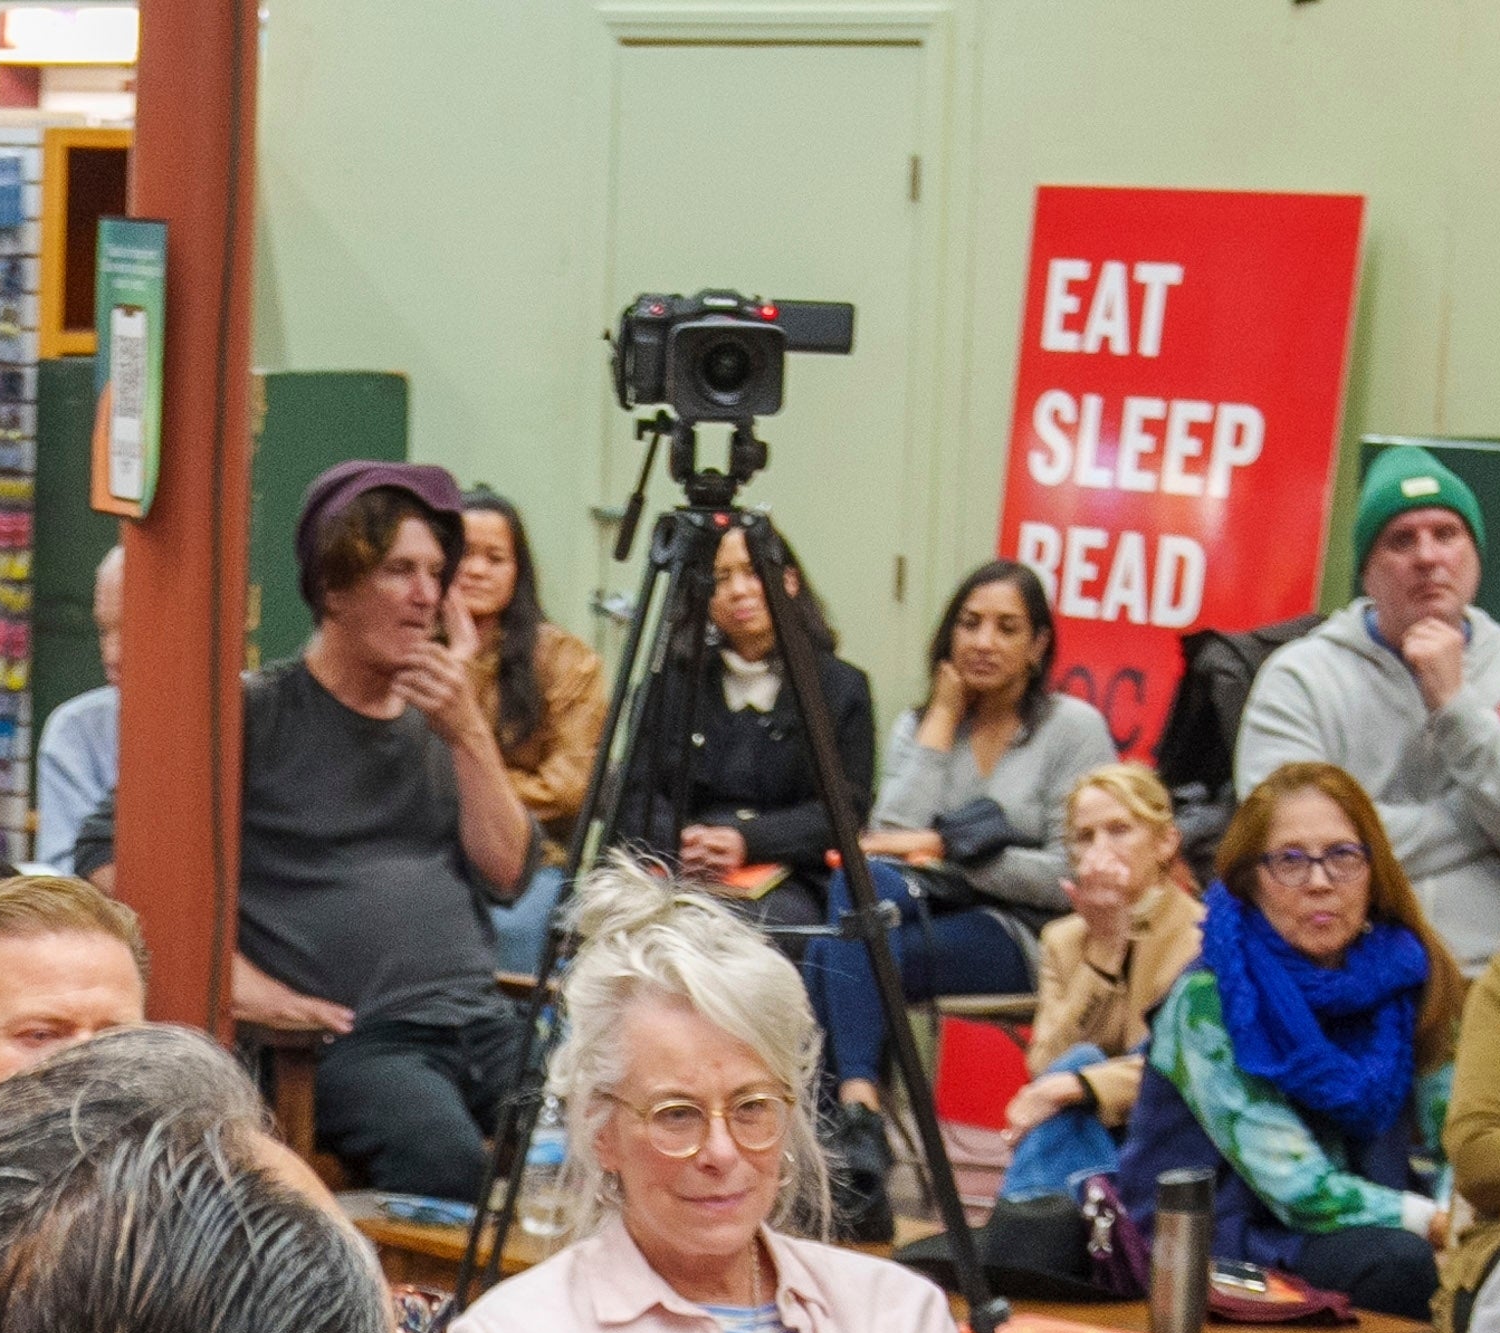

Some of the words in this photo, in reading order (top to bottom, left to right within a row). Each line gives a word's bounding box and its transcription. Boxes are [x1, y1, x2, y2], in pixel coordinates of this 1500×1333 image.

[1040, 258, 1184, 358] EAT
[1027, 389, 1265, 499] SLEEP
[1016, 520, 1208, 629] READ
